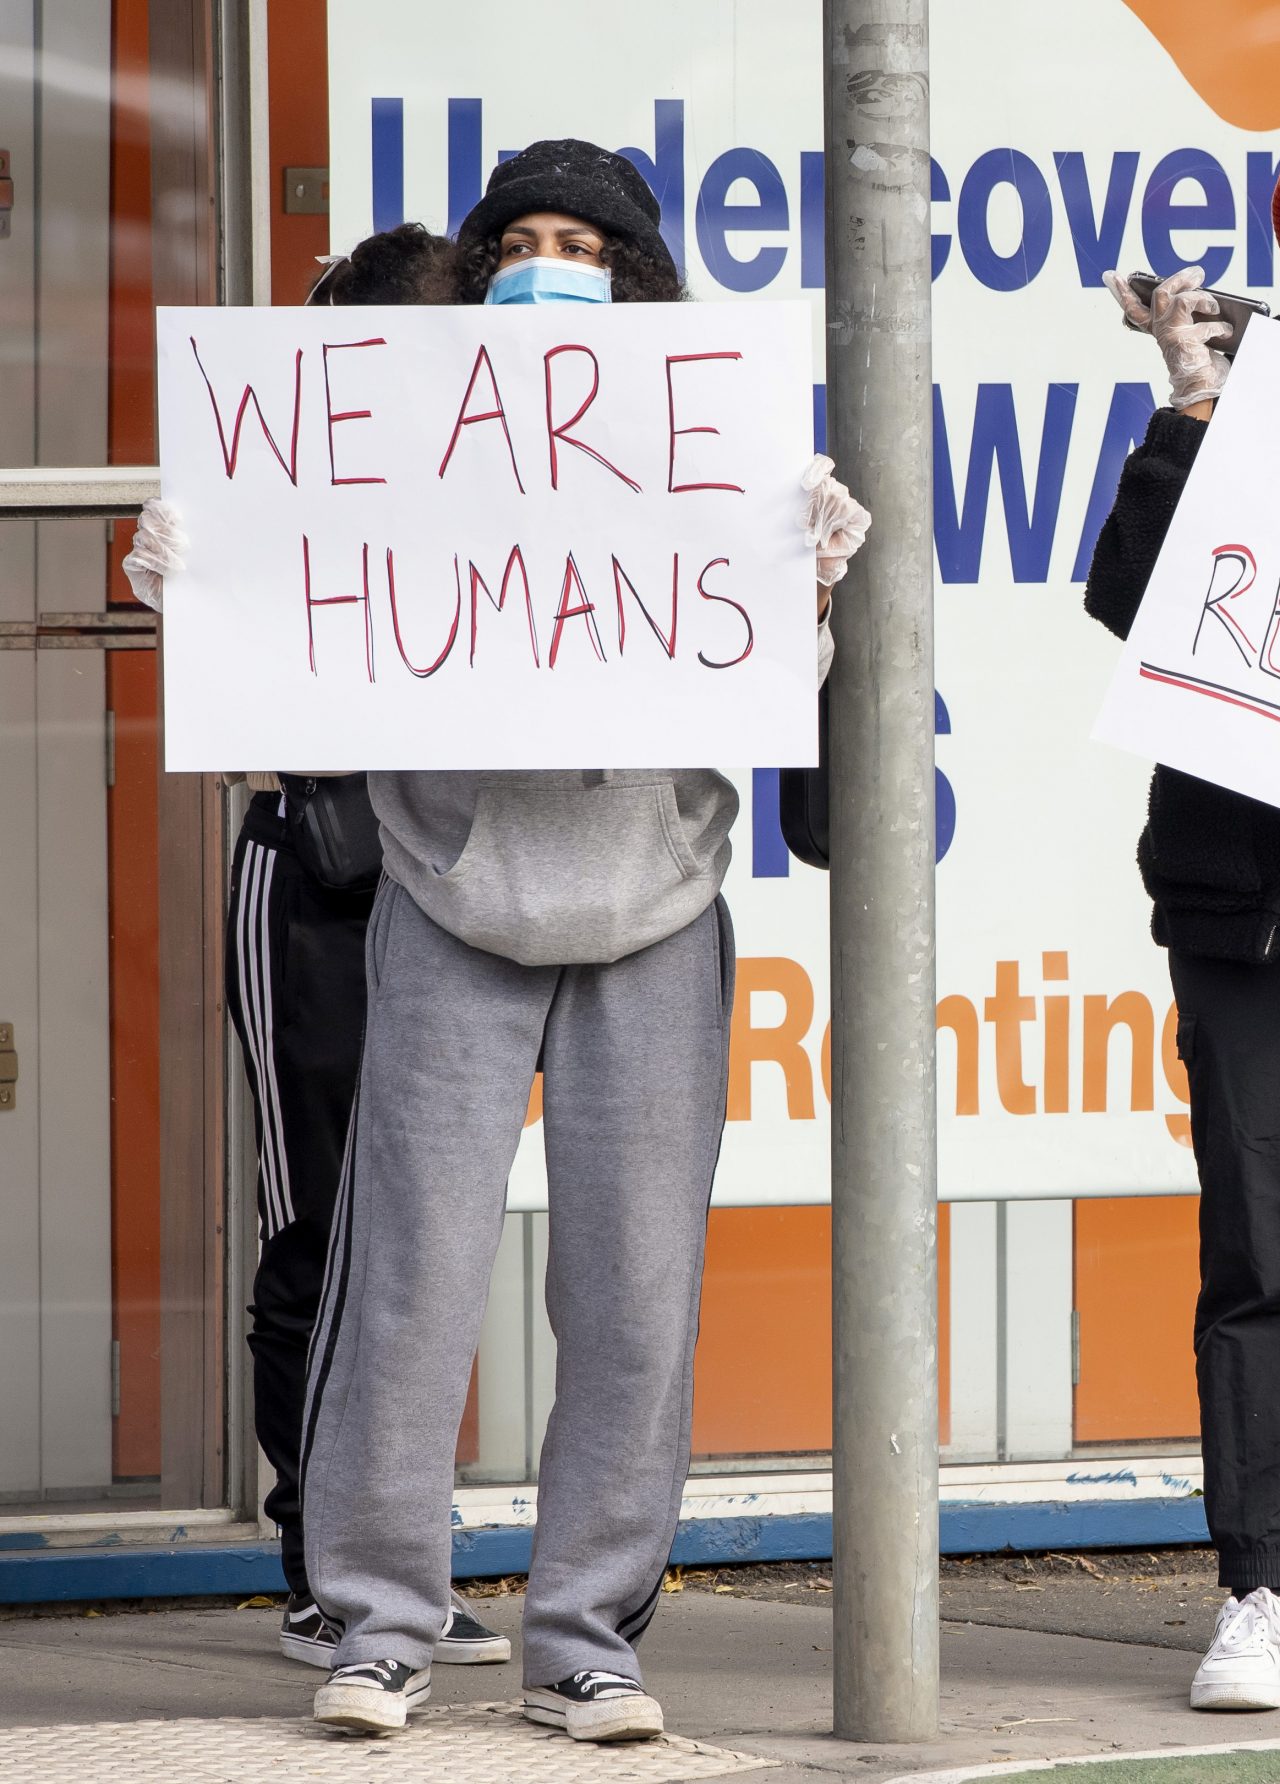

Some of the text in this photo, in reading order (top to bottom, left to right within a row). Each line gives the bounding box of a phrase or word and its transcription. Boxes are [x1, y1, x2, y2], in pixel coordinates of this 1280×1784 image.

[190, 336, 387, 487] WE
[439, 344, 745, 495] ARE
[302, 534, 754, 683] HUMANS
